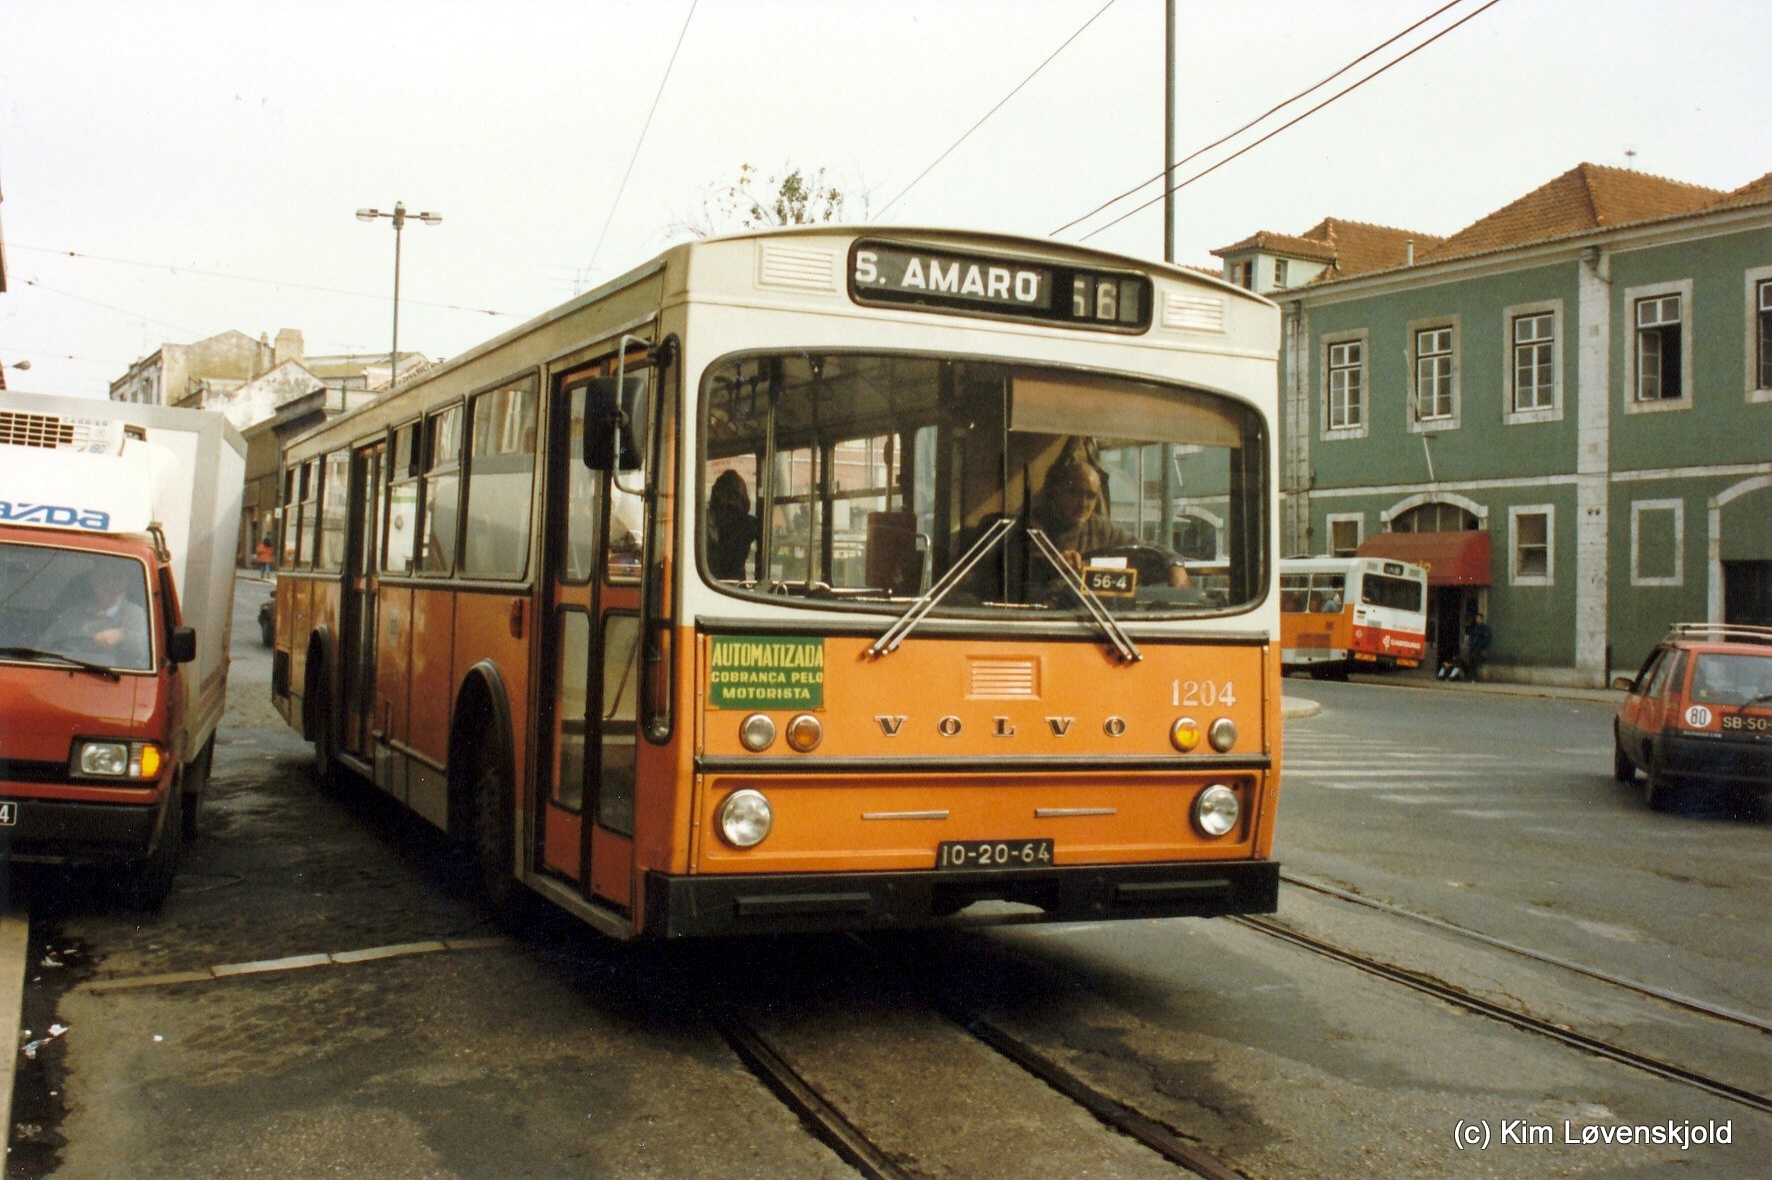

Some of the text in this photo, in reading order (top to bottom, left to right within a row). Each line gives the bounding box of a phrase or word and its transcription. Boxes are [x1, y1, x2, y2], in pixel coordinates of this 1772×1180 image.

[855, 251, 886, 284] S.
[901, 257, 1039, 302] AMARO
[1093, 574, 1127, 589] 56-4
[712, 643, 823, 667] AUTOMATIZADA
[711, 672, 823, 684] COBRANÇA PELO
[722, 687, 811, 699] MOTORISTA
[1171, 679, 1237, 707] 1204
[874, 715, 1127, 737] VOLVO
[1690, 707, 1707, 726] 80
[942, 842, 1050, 866] 10-20-64
